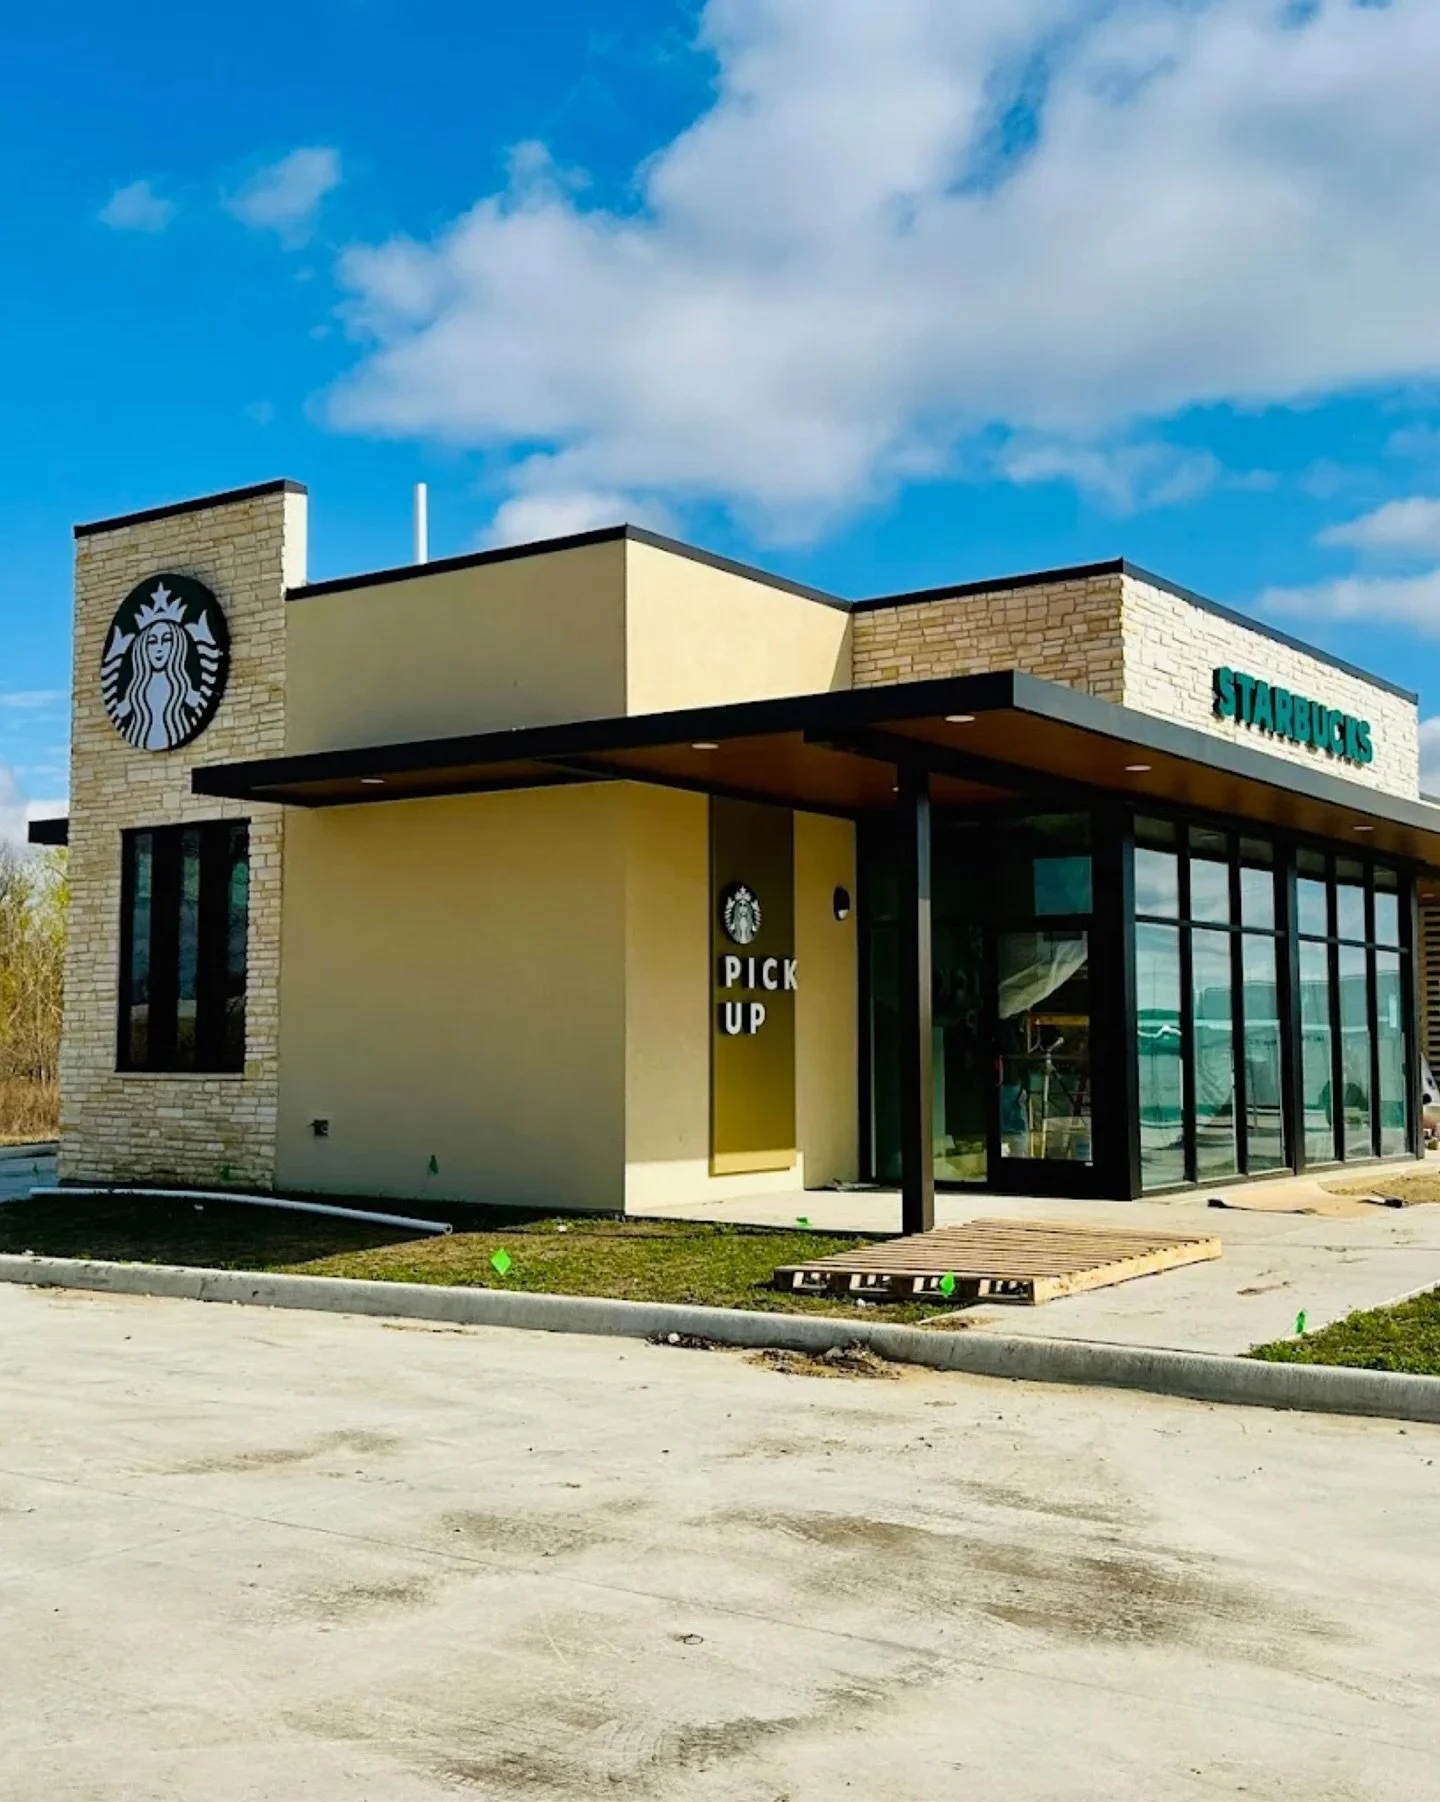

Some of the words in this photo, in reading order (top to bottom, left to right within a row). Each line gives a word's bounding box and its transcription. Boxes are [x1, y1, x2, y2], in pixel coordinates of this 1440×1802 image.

[1215, 666, 1373, 764] STARBUCKS
[724, 955, 799, 990] PICK
[725, 1001, 766, 1034] UP
